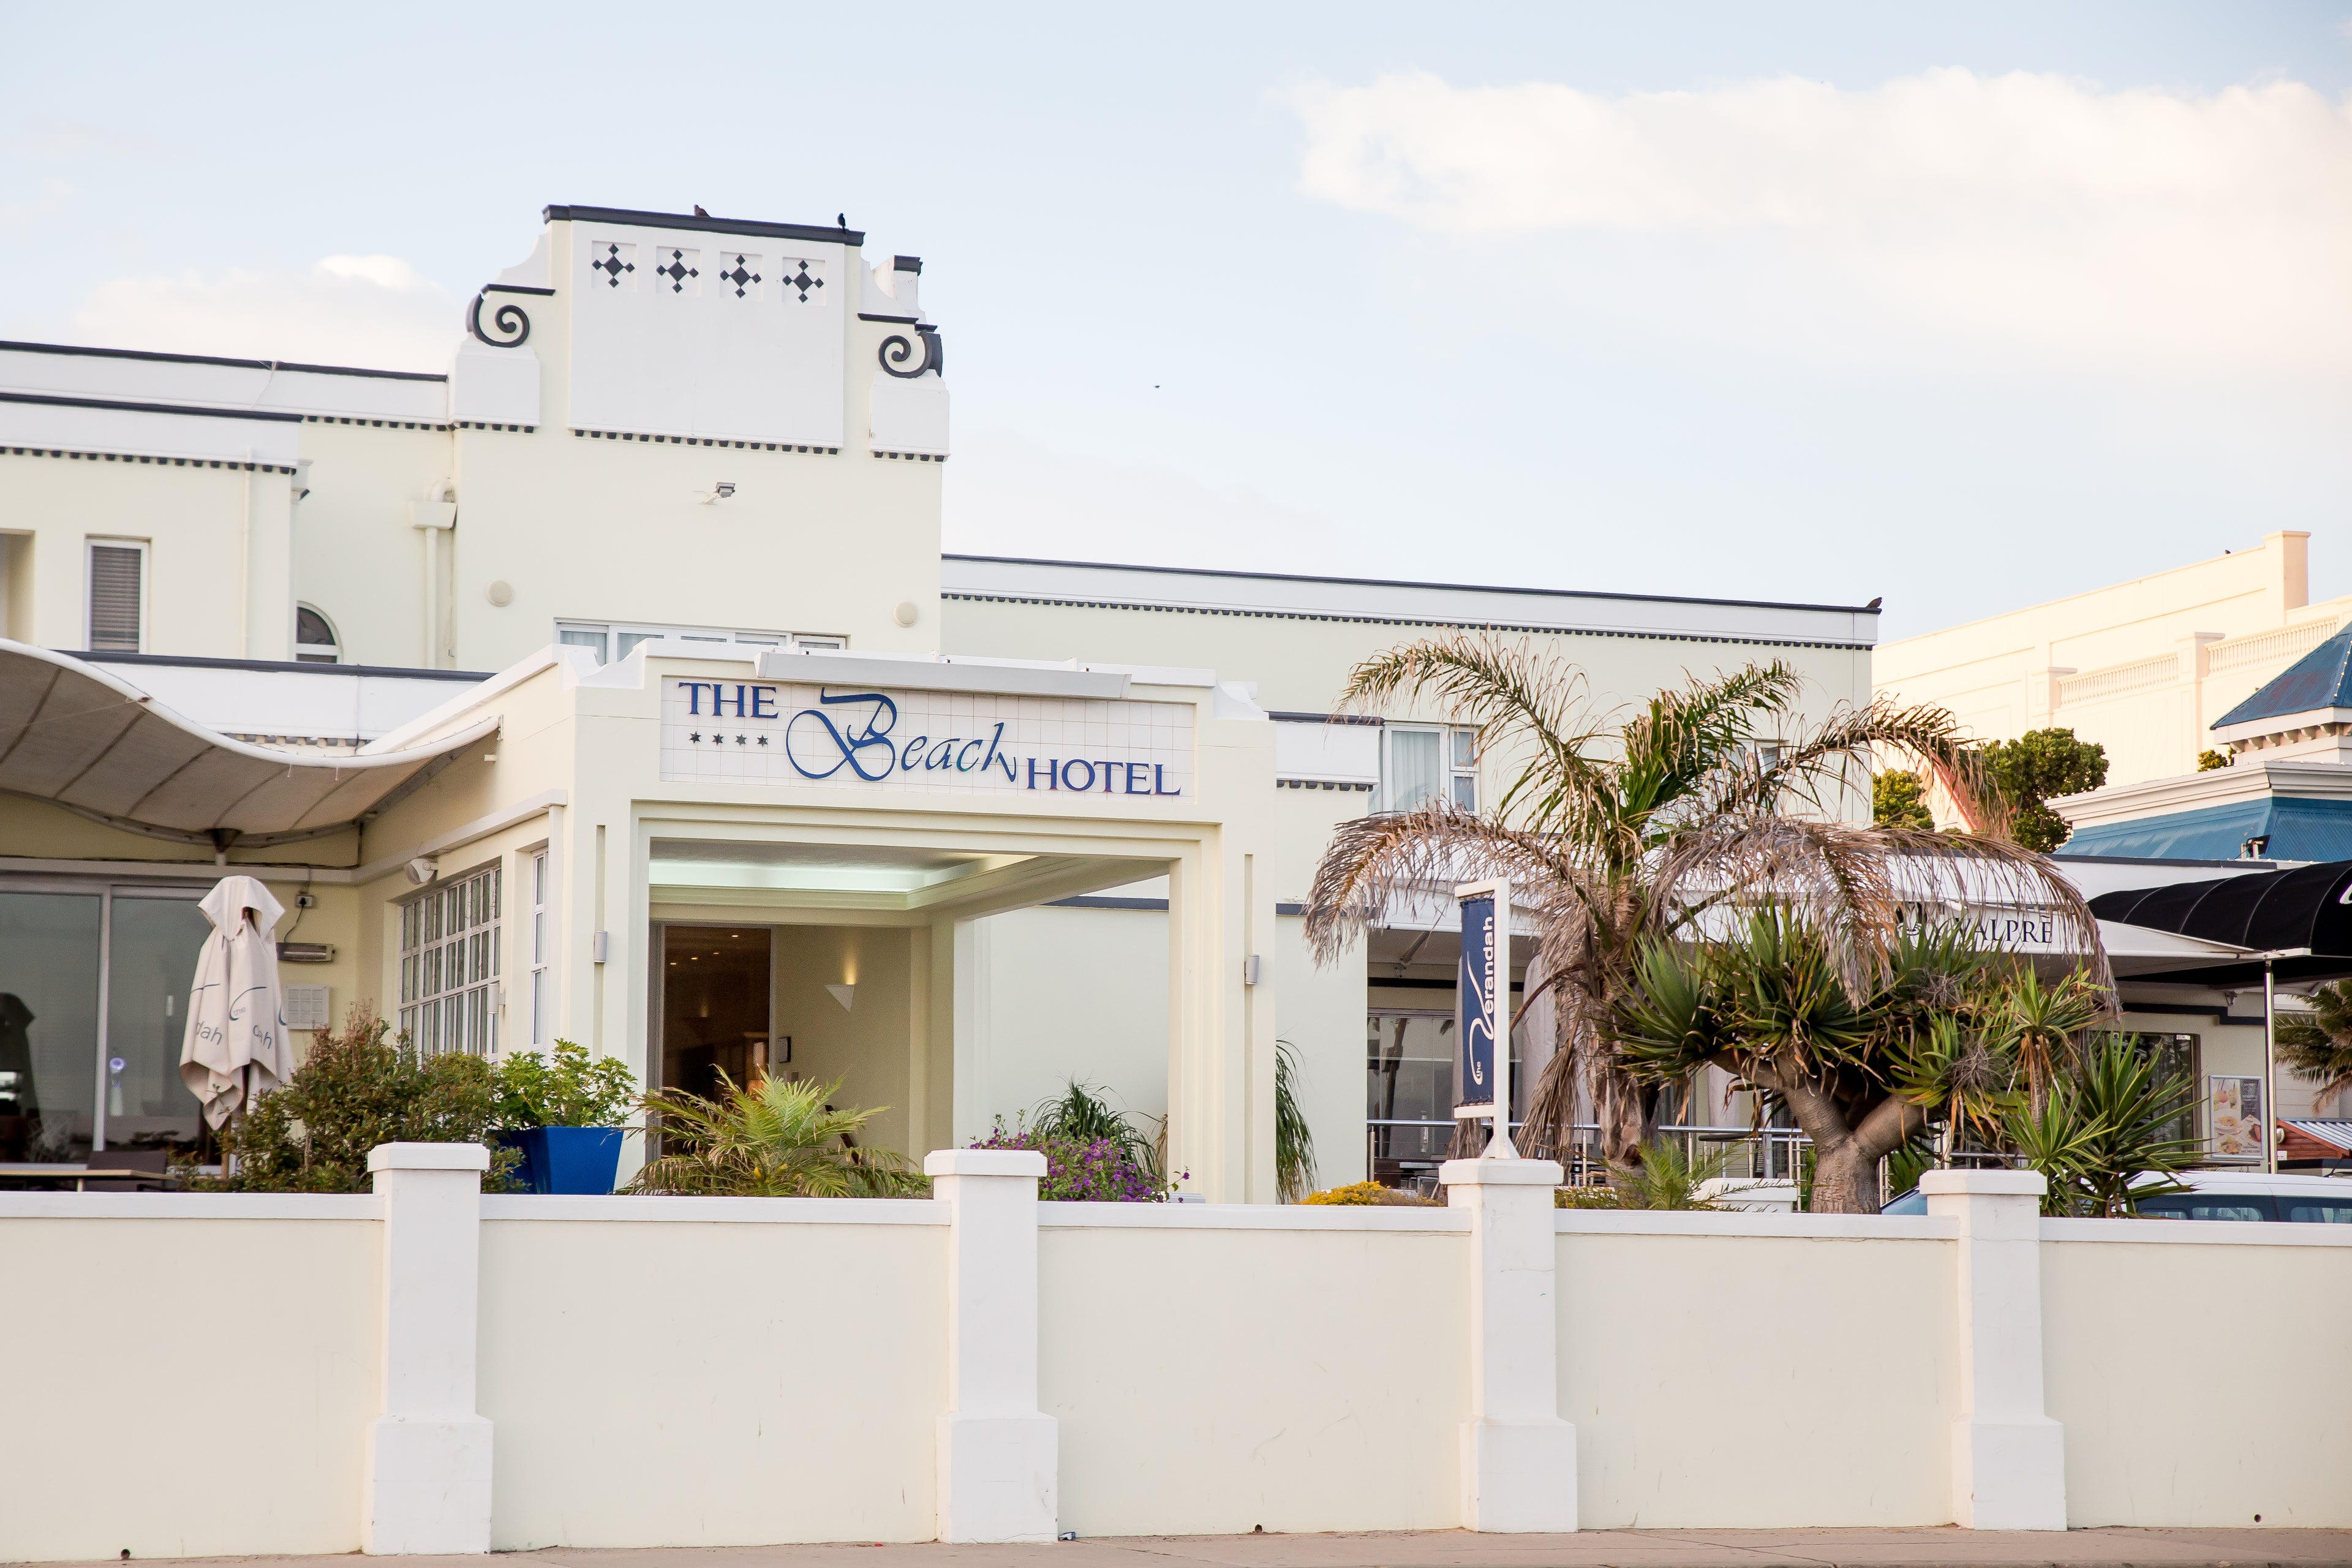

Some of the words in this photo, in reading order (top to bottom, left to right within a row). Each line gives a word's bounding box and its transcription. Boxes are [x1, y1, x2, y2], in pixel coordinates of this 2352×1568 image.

[678, 682, 778, 719] THE
[786, 686, 1017, 782] Beach
[1027, 758, 1181, 796] HOTEL
[1468, 916, 1494, 1085] Verandah
